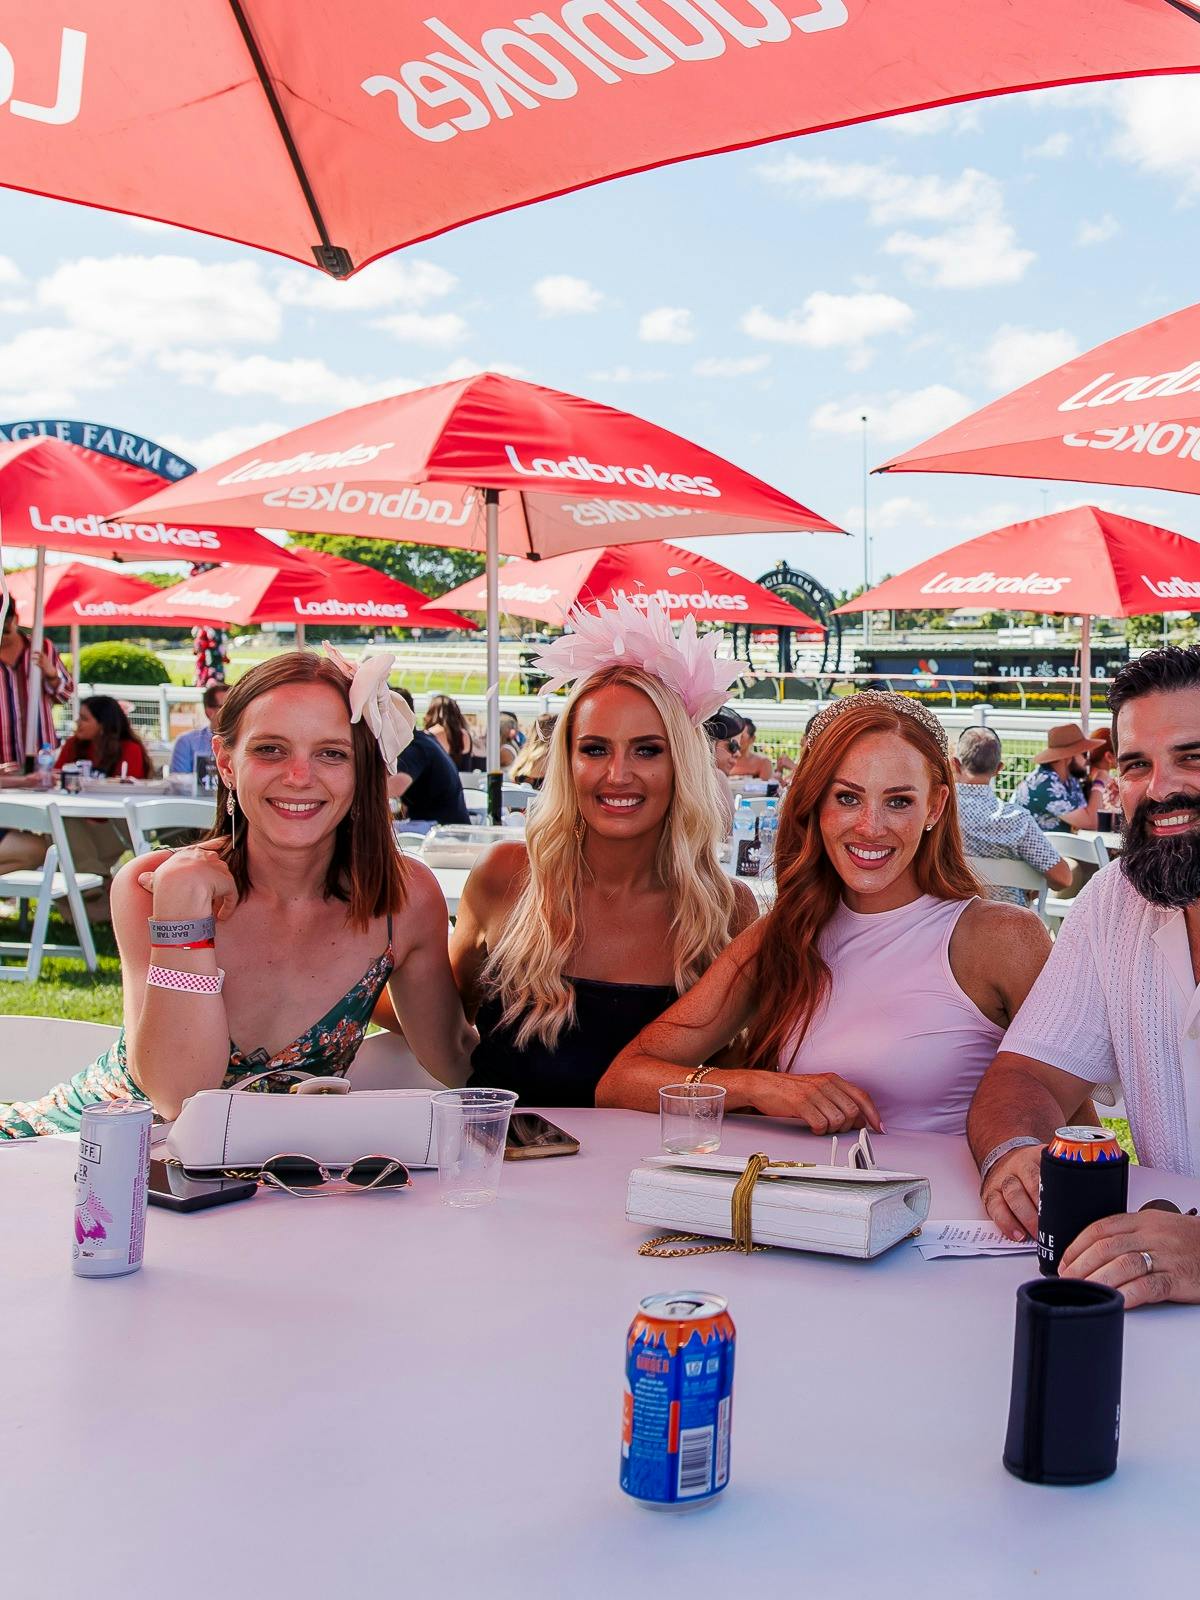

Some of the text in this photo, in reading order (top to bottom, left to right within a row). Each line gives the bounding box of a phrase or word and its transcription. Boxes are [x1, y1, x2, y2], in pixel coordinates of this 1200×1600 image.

[83, 424, 163, 470] FARM
[505, 444, 721, 497] Ladbrokes
[29, 507, 221, 549] Ladbrokes
[920, 572, 1072, 596] Ladbrokes
[293, 597, 409, 618] Ladbrokes
[998, 666, 1106, 679] THE STR
